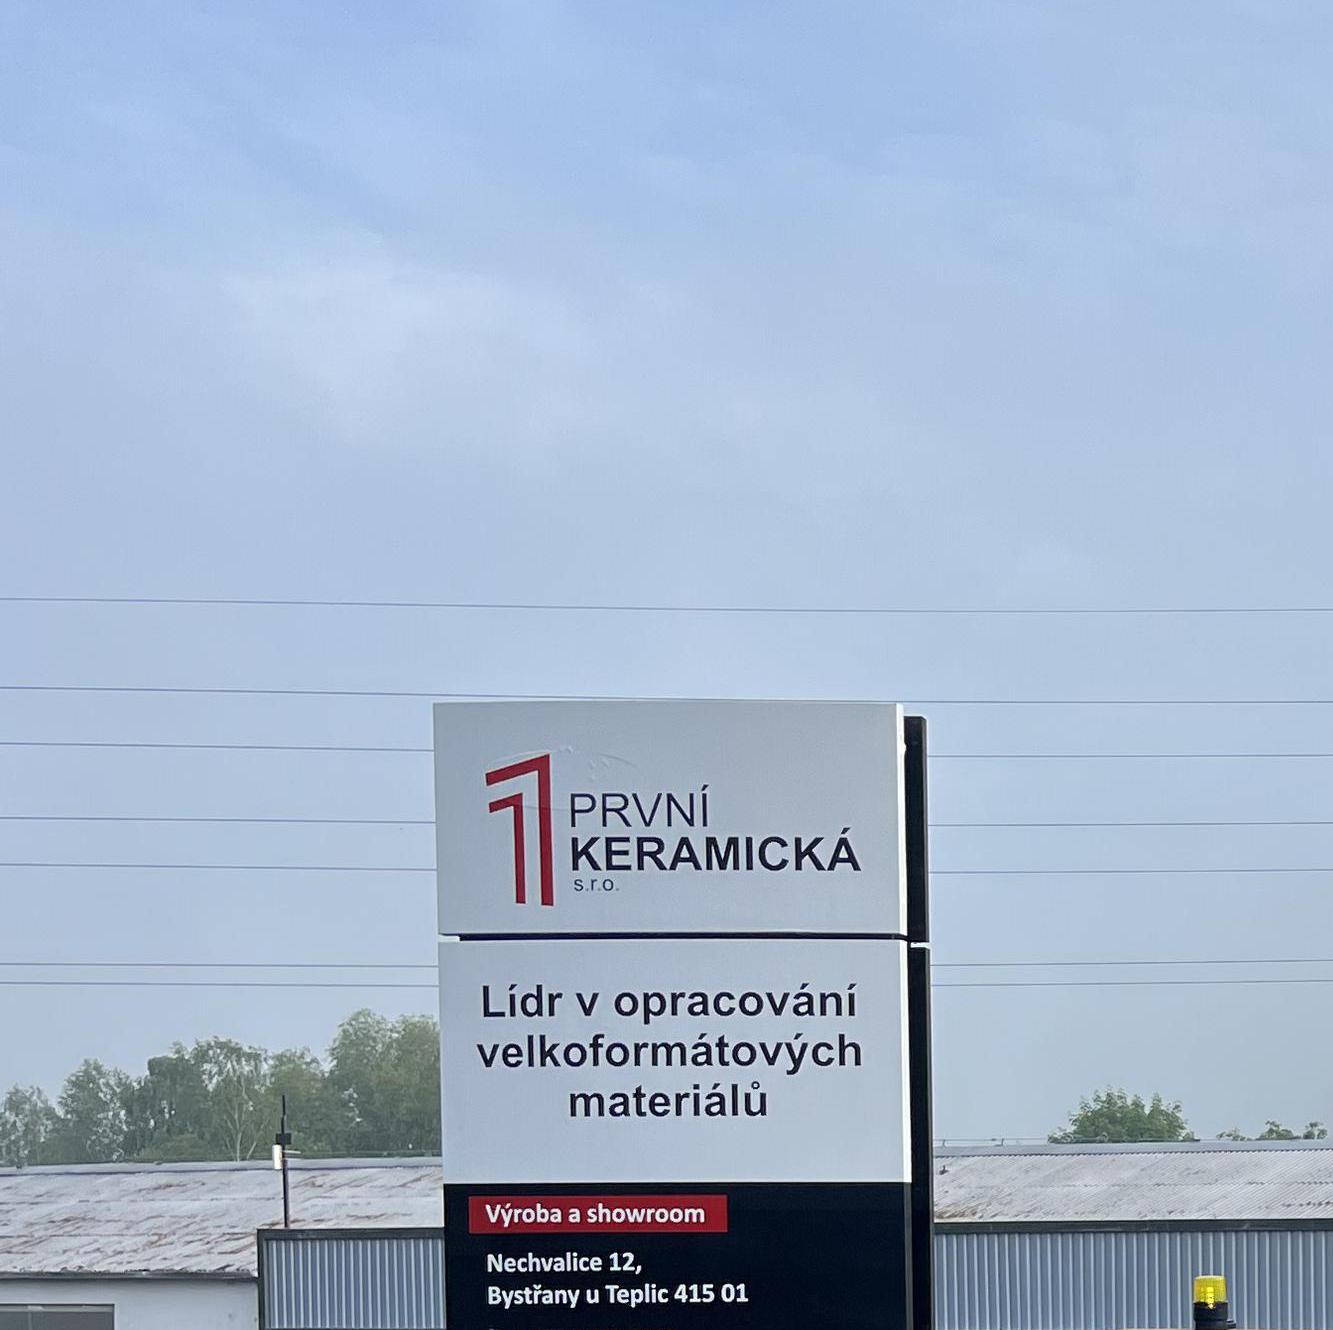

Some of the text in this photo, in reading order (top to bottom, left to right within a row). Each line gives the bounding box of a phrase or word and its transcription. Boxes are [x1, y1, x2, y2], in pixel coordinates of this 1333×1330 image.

[570, 784, 709, 828] PRVNÍ
[571, 827, 862, 872] KERAMICKÁ
[573, 877, 620, 892] s.r.o.
[482, 982, 857, 1026] Lídr v opracování
[476, 1032, 862, 1076] velkoformátových
[569, 1080, 767, 1118] materiálů
[485, 1202, 705, 1228] Výroba a showroom
[487, 1251, 642, 1275] Nechvalice 12,
[487, 1283, 749, 1310] Bystřany u Teplic 415 01
